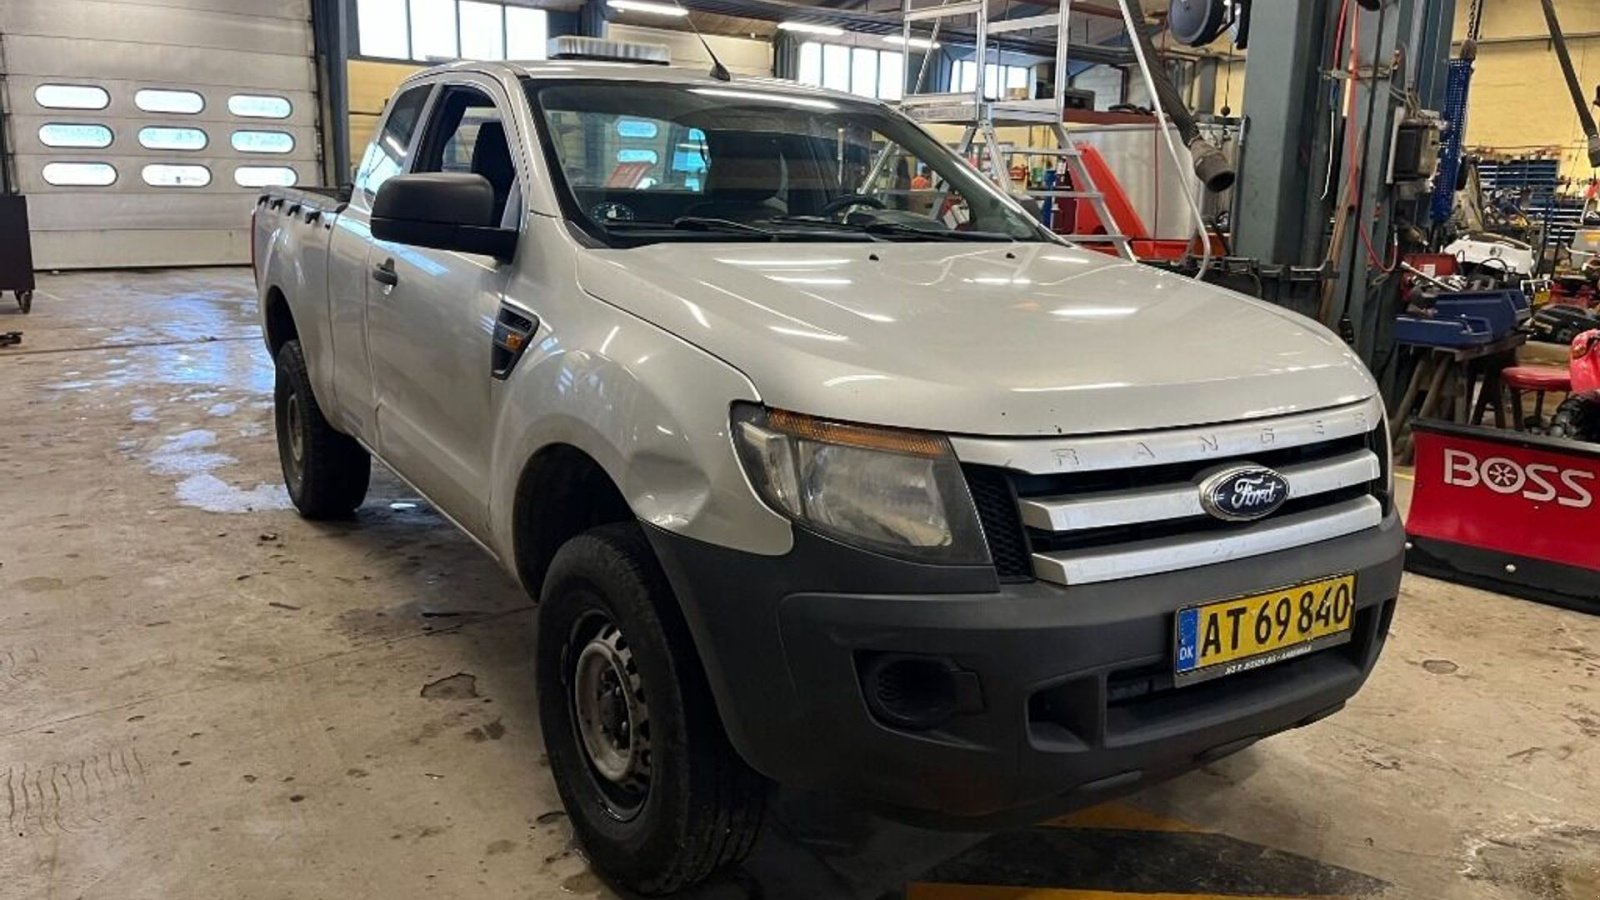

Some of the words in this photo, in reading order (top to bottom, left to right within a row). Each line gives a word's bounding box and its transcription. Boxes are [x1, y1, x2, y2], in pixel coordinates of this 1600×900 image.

[1051, 411, 1367, 467] RANGER
[1231, 477, 1276, 509] Ford
[1444, 448, 1595, 508] BOSS
[1201, 606, 1247, 657] AT
[1254, 597, 1292, 645] 69
[1297, 583, 1349, 634] 840
[1179, 646, 1193, 661] DK
